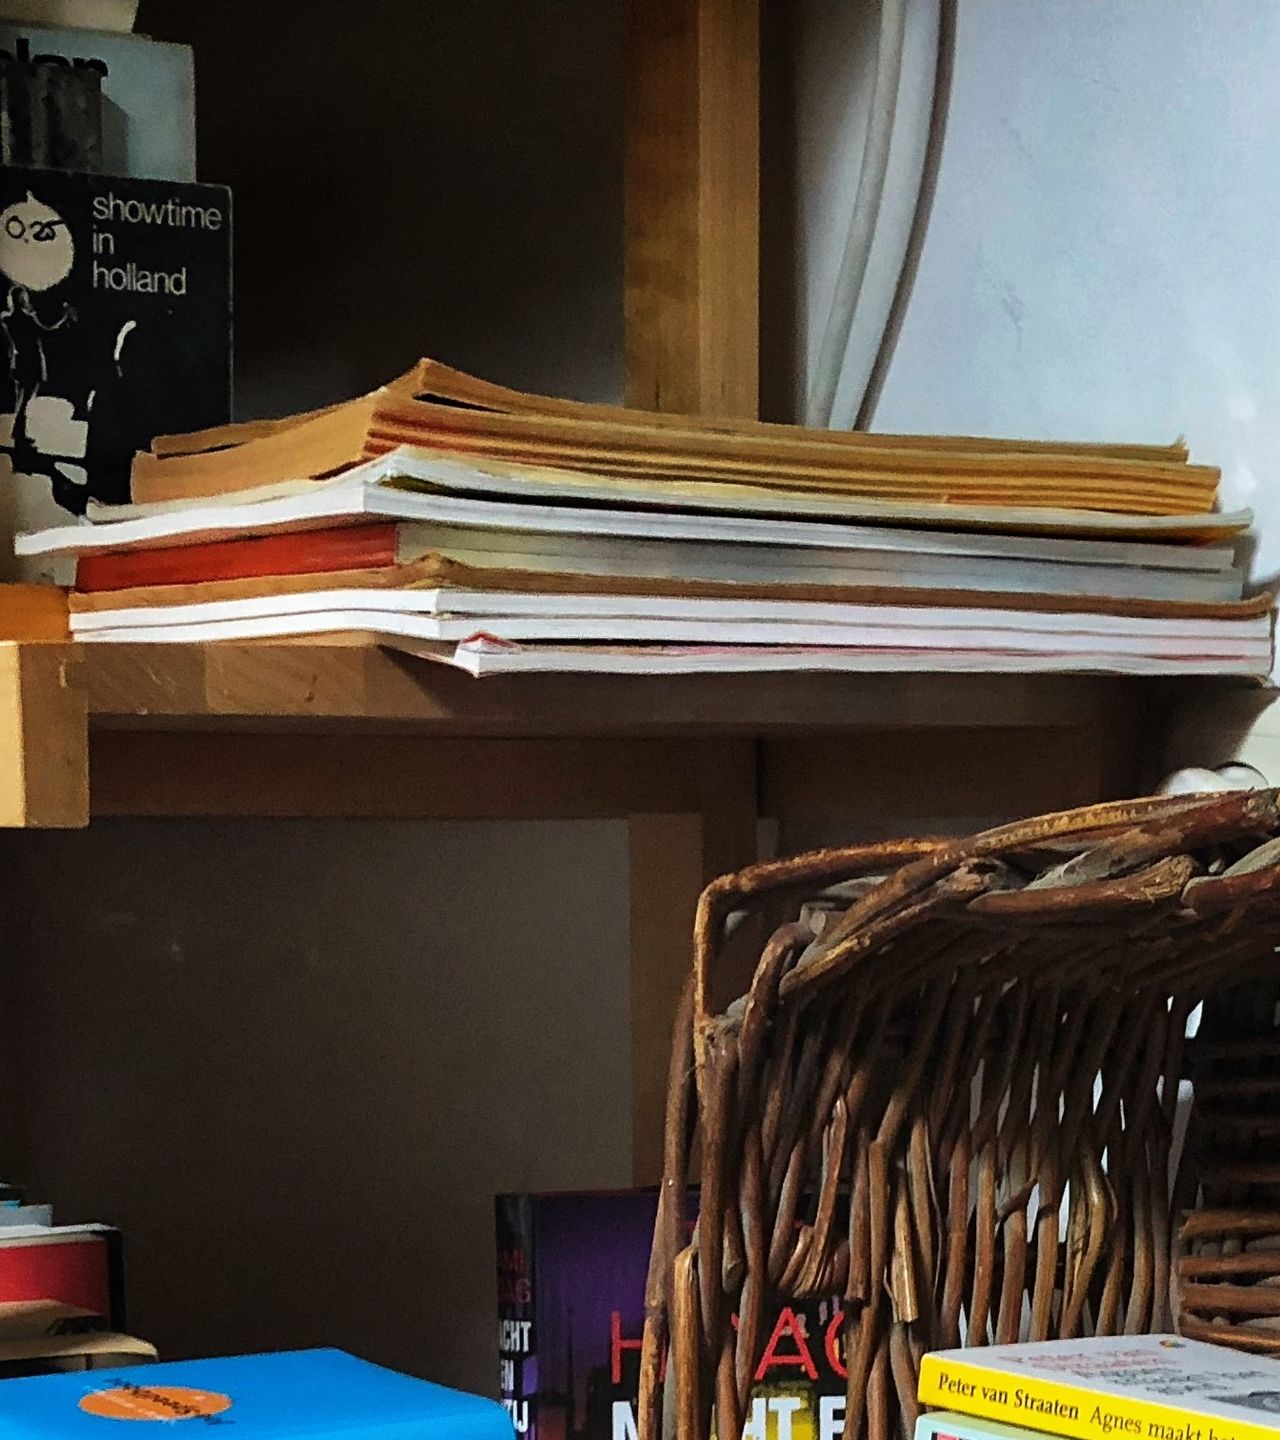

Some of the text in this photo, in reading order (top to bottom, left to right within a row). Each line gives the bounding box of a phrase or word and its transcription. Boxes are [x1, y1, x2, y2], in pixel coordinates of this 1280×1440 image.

[92, 191, 223, 231] showtime
[92, 224, 115, 255] in
[92, 259, 187, 296] holland
[938, 1372, 977, 1398] Peter
[981, 1387, 1008, 1405] van
[1013, 1389, 1079, 1420] Straaten
[1089, 1405, 1142, 1434] Agnes
